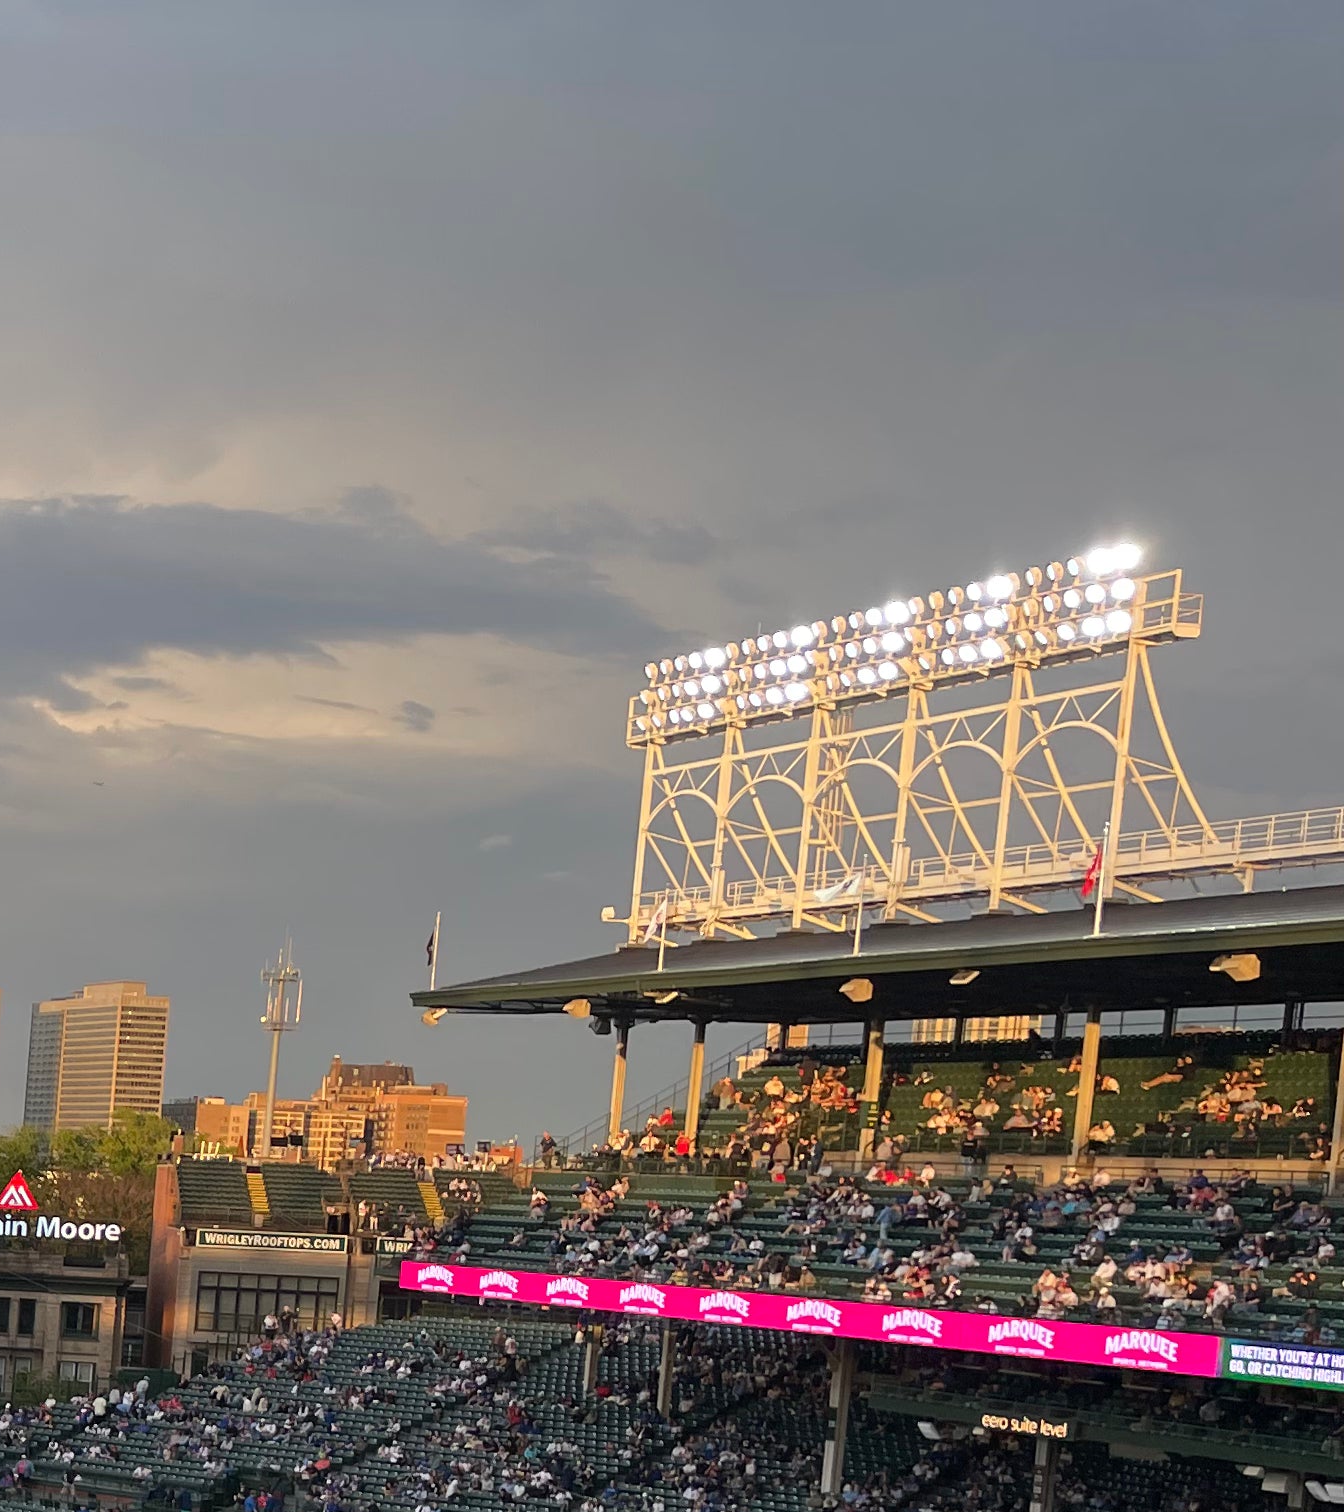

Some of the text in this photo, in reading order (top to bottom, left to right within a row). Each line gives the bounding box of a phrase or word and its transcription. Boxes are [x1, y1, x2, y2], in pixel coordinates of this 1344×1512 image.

[36, 1216, 121, 1241] Moore
[204, 1232, 340, 1250] WRIGLEYROOFTOPS.COM
[417, 1265, 454, 1288] MARQUEE
[479, 1271, 519, 1294] MARQUEE
[546, 1277, 589, 1301] MARQUEE
[619, 1284, 666, 1309] MARQUEE
[699, 1292, 750, 1318] MARQUEE
[786, 1300, 842, 1327] MARQUEE
[882, 1309, 943, 1339] MARQUEE
[988, 1319, 1055, 1349] MARQUEE
[1105, 1331, 1178, 1362] MARQUEE
[1230, 1344, 1278, 1362] WHETHER
[1279, 1348, 1315, 1366] YOU'RE
[1315, 1352, 1331, 1367] AT
[1229, 1359, 1246, 1375] GO,
[1248, 1361, 1262, 1375] OR
[1263, 1362, 1312, 1381] CATCHING
[981, 1413, 1068, 1438] eero suite level
